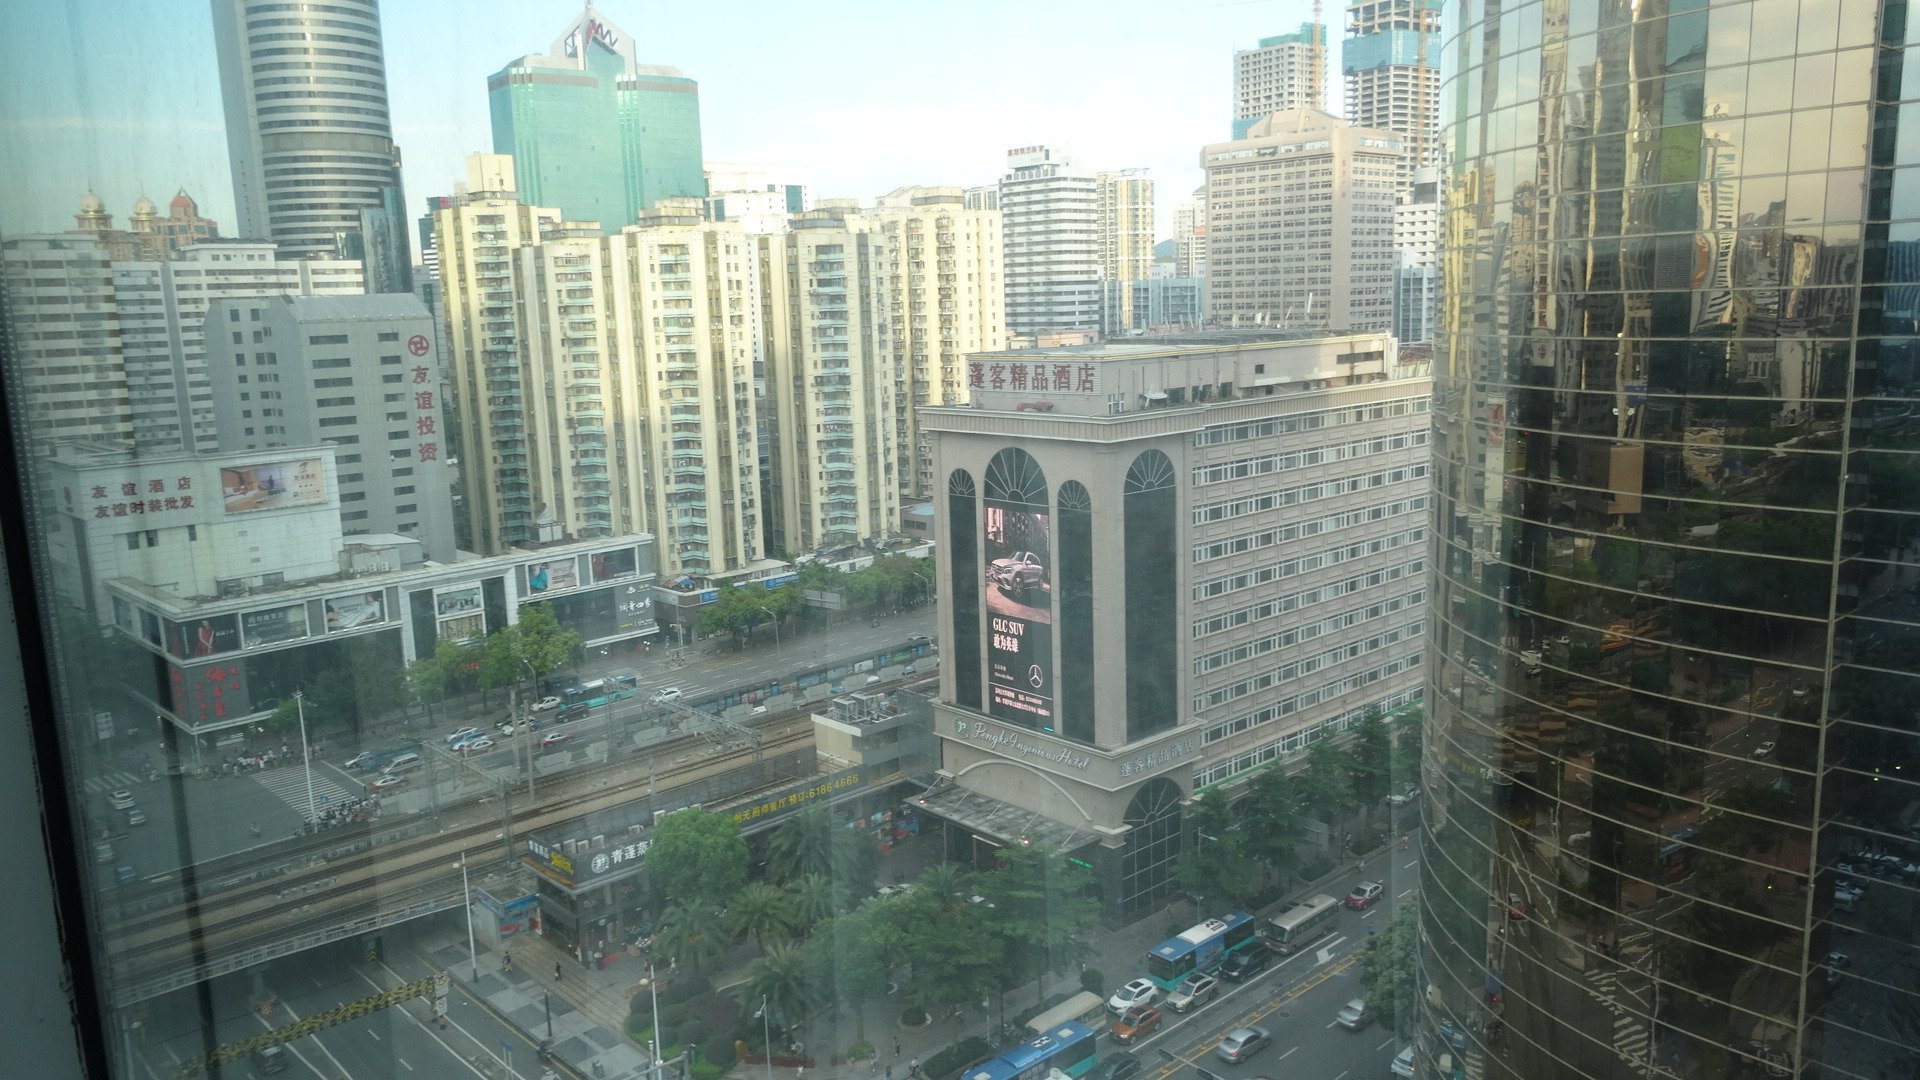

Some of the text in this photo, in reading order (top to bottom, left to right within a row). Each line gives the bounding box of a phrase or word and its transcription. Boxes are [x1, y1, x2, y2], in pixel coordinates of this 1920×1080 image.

[969, 362, 1095, 392] 蓬客精品酒店
[411, 366, 437, 462] 友谊投资
[91, 476, 191, 499] 友谊酒店
[94, 495, 194, 520] 友谊时装批发
[993, 618, 1024, 636] GLC SUV
[974, 722, 1010, 750] Pengke
[1056, 748, 1090, 771] Hotel
[1120, 739, 1195, 777] 蓬客精品酒店
